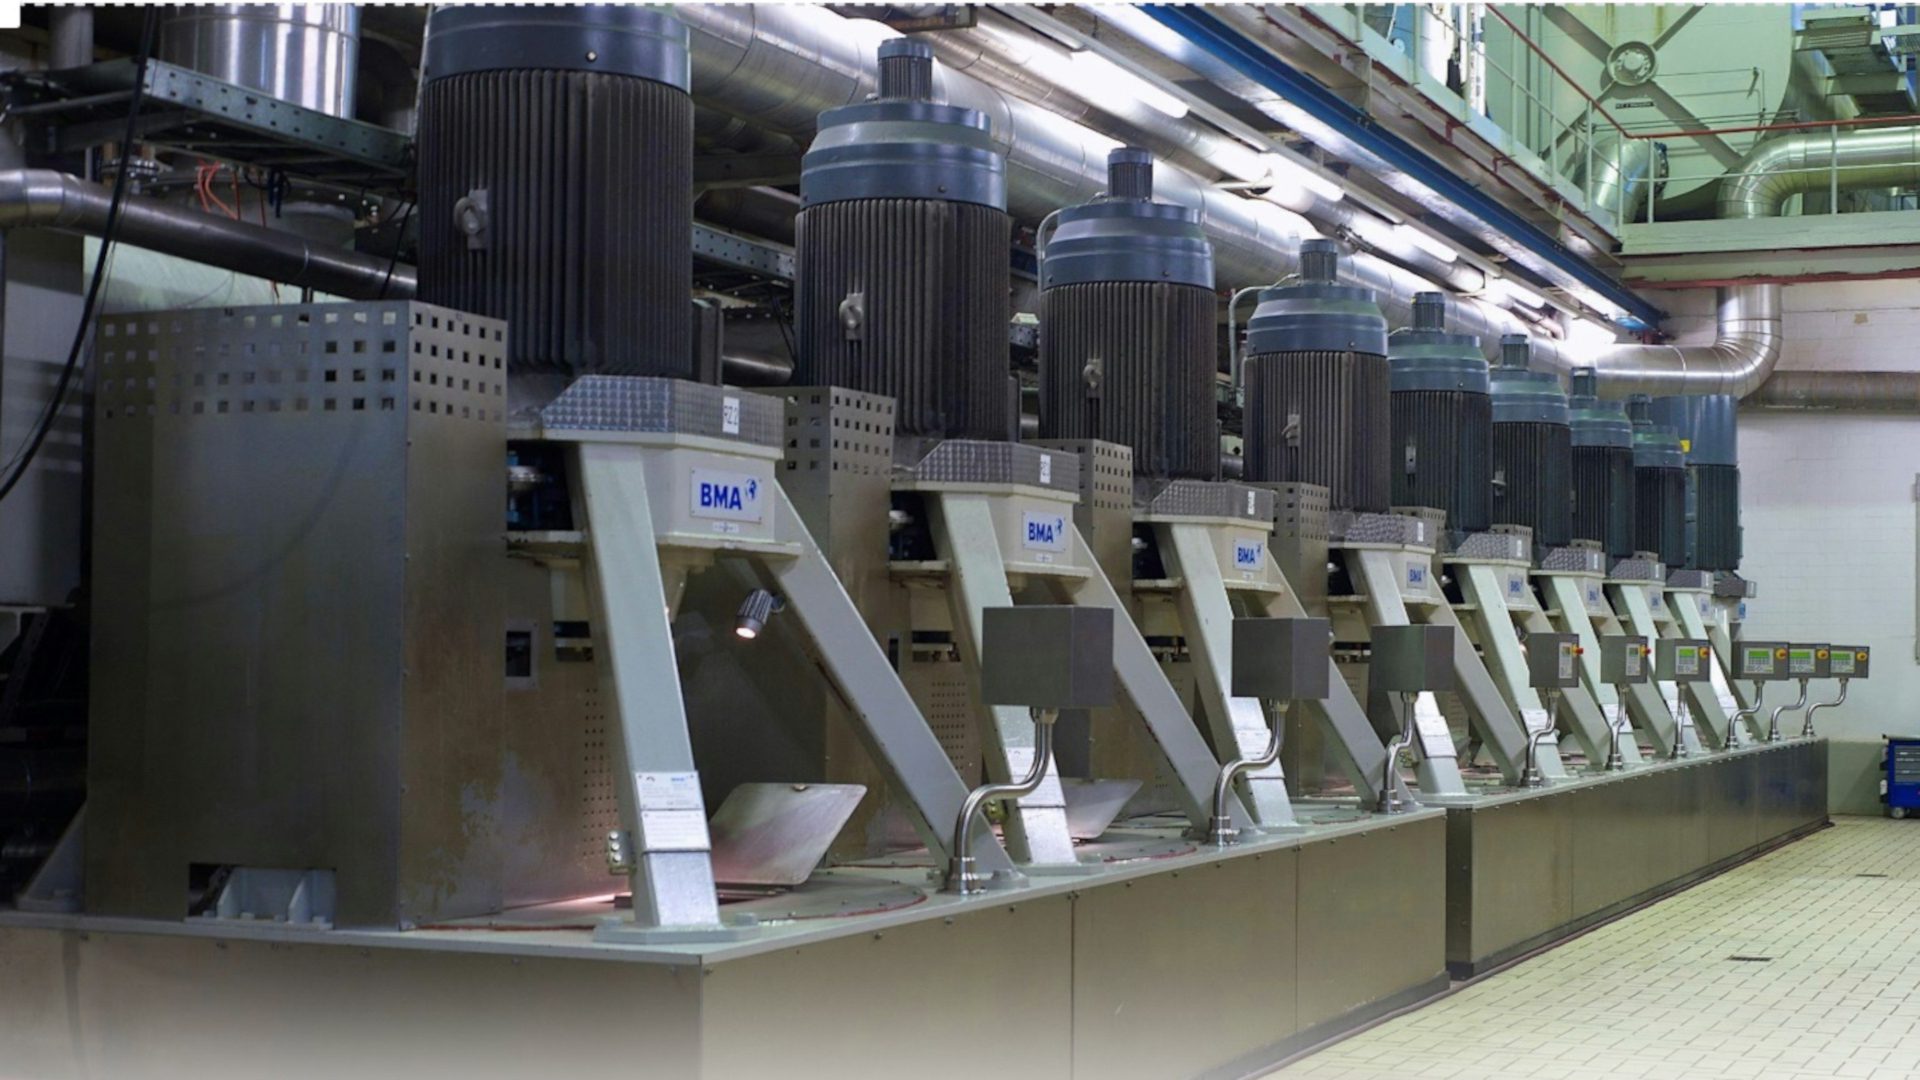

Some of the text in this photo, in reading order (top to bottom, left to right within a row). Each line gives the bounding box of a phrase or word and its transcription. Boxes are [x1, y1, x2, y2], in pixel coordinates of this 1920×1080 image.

[701, 483, 742, 510] BMA
[1028, 522, 1054, 543] BMA
[1238, 547, 1255, 564] BMA
